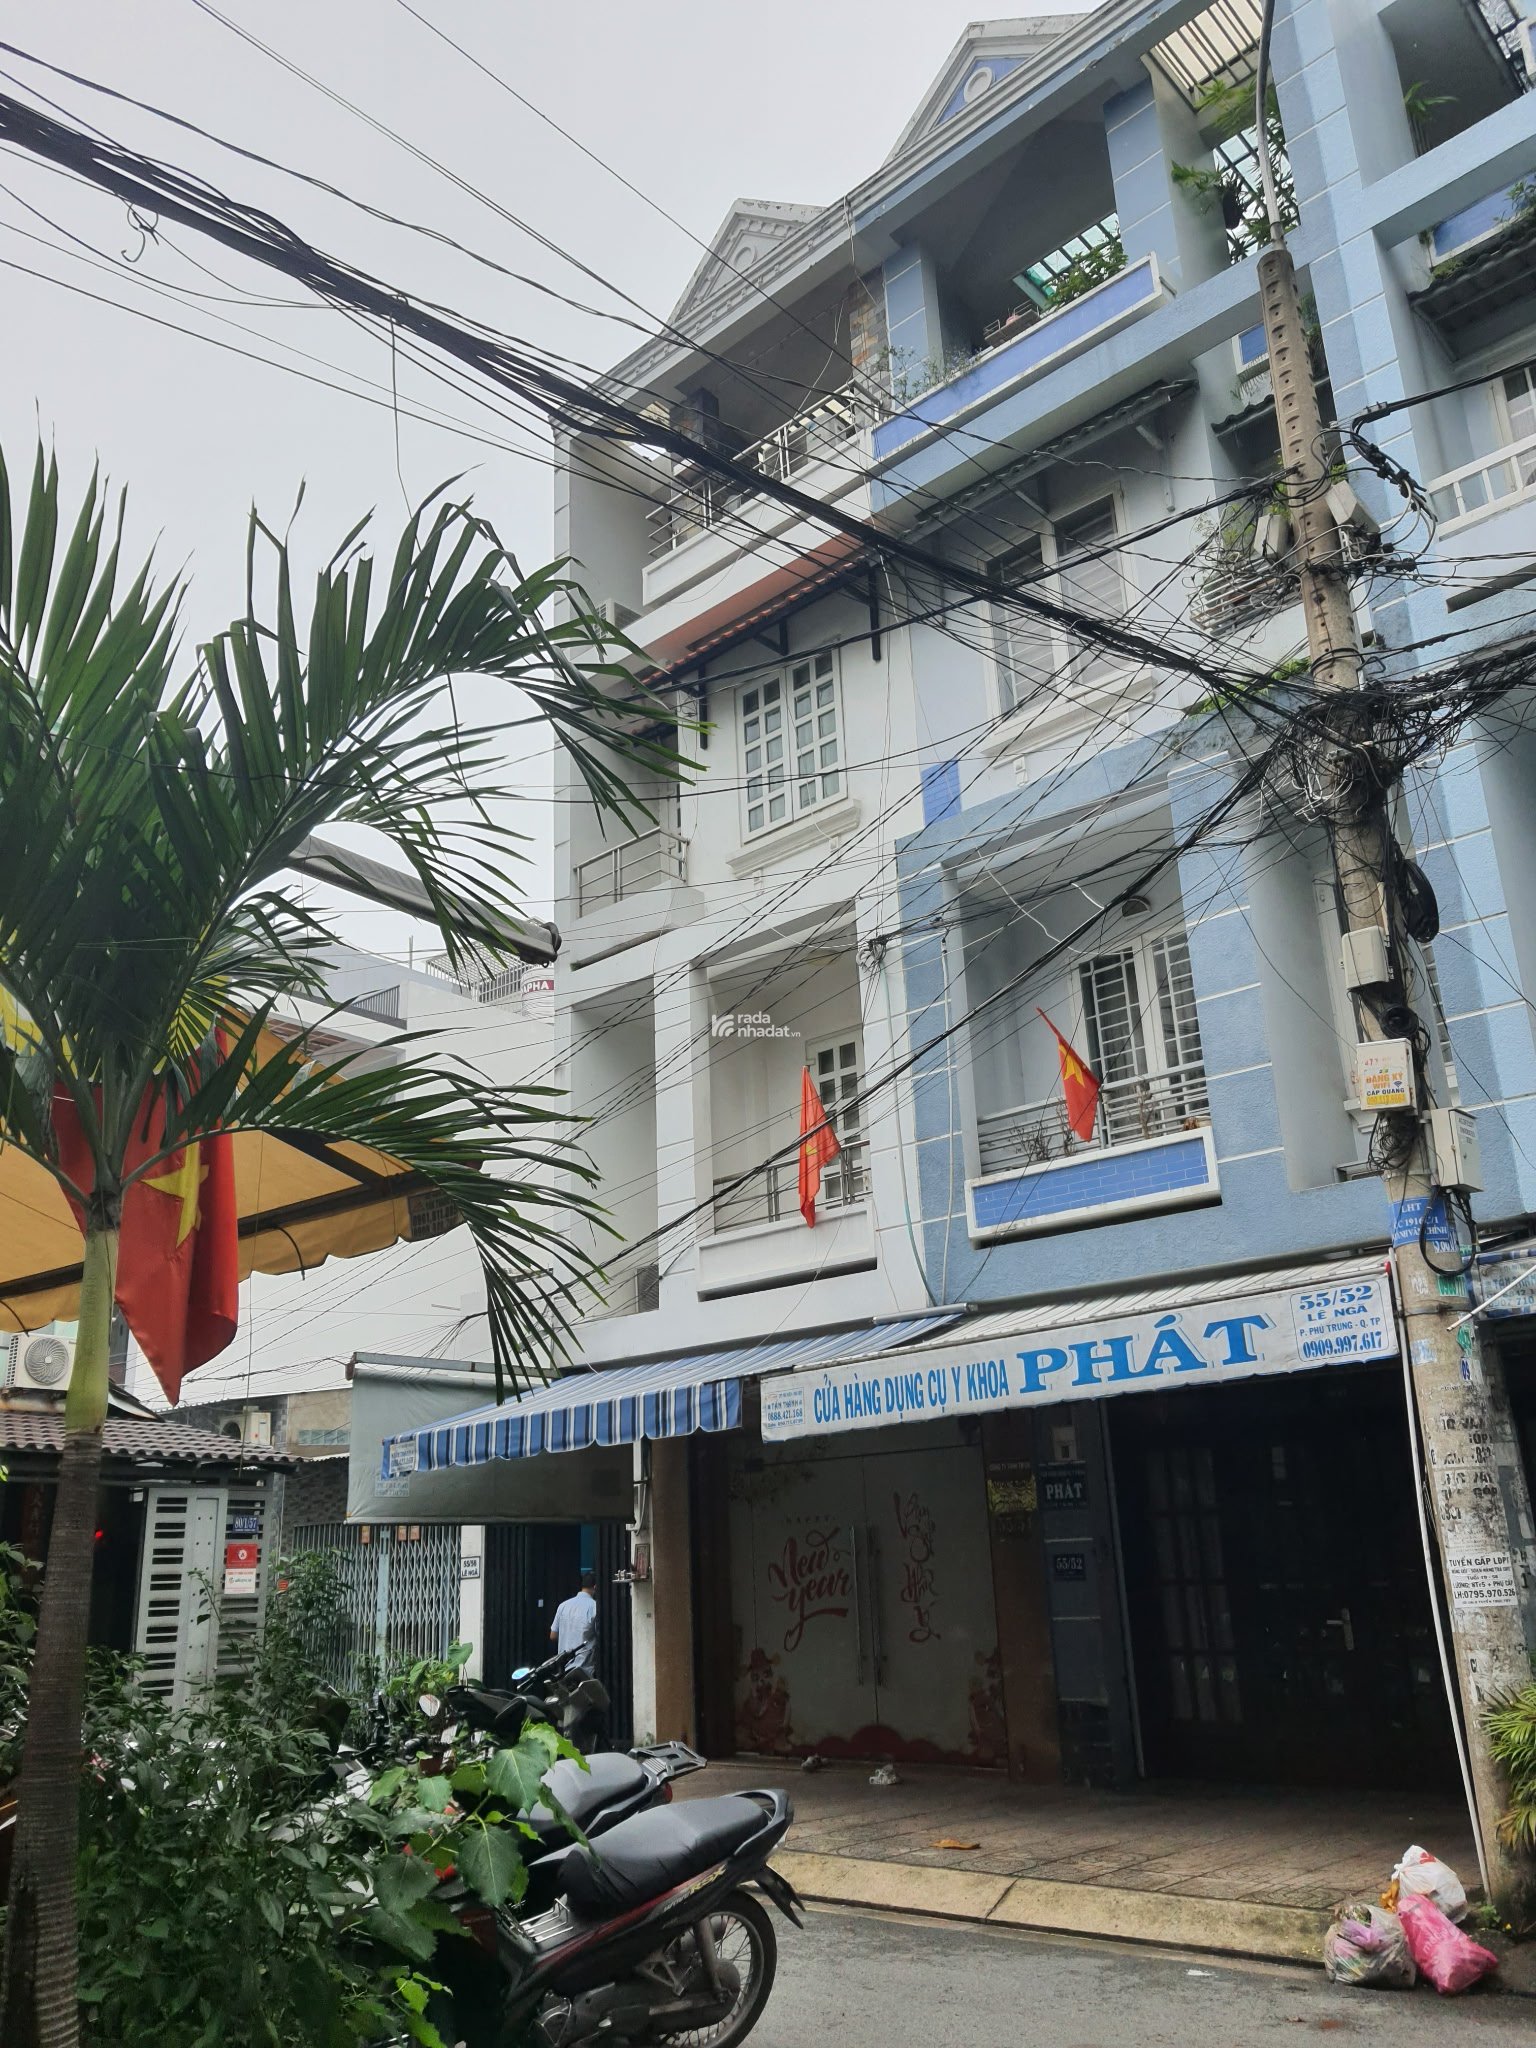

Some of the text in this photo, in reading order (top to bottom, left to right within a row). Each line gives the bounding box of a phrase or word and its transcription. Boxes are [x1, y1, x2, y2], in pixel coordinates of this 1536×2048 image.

[1299, 1285, 1374, 1310] 55/52
[1307, 1309, 1327, 1322] LÊ
[1327, 1321, 1353, 1332] TRUNG
[1302, 1331, 1383, 1359] 0909.997.617
[813, 1312, 1277, 1424] CỬA HÀNG DỤNG CỤ Y KHOA PHÁT
[1045, 1479, 1083, 1499] PHÁT
